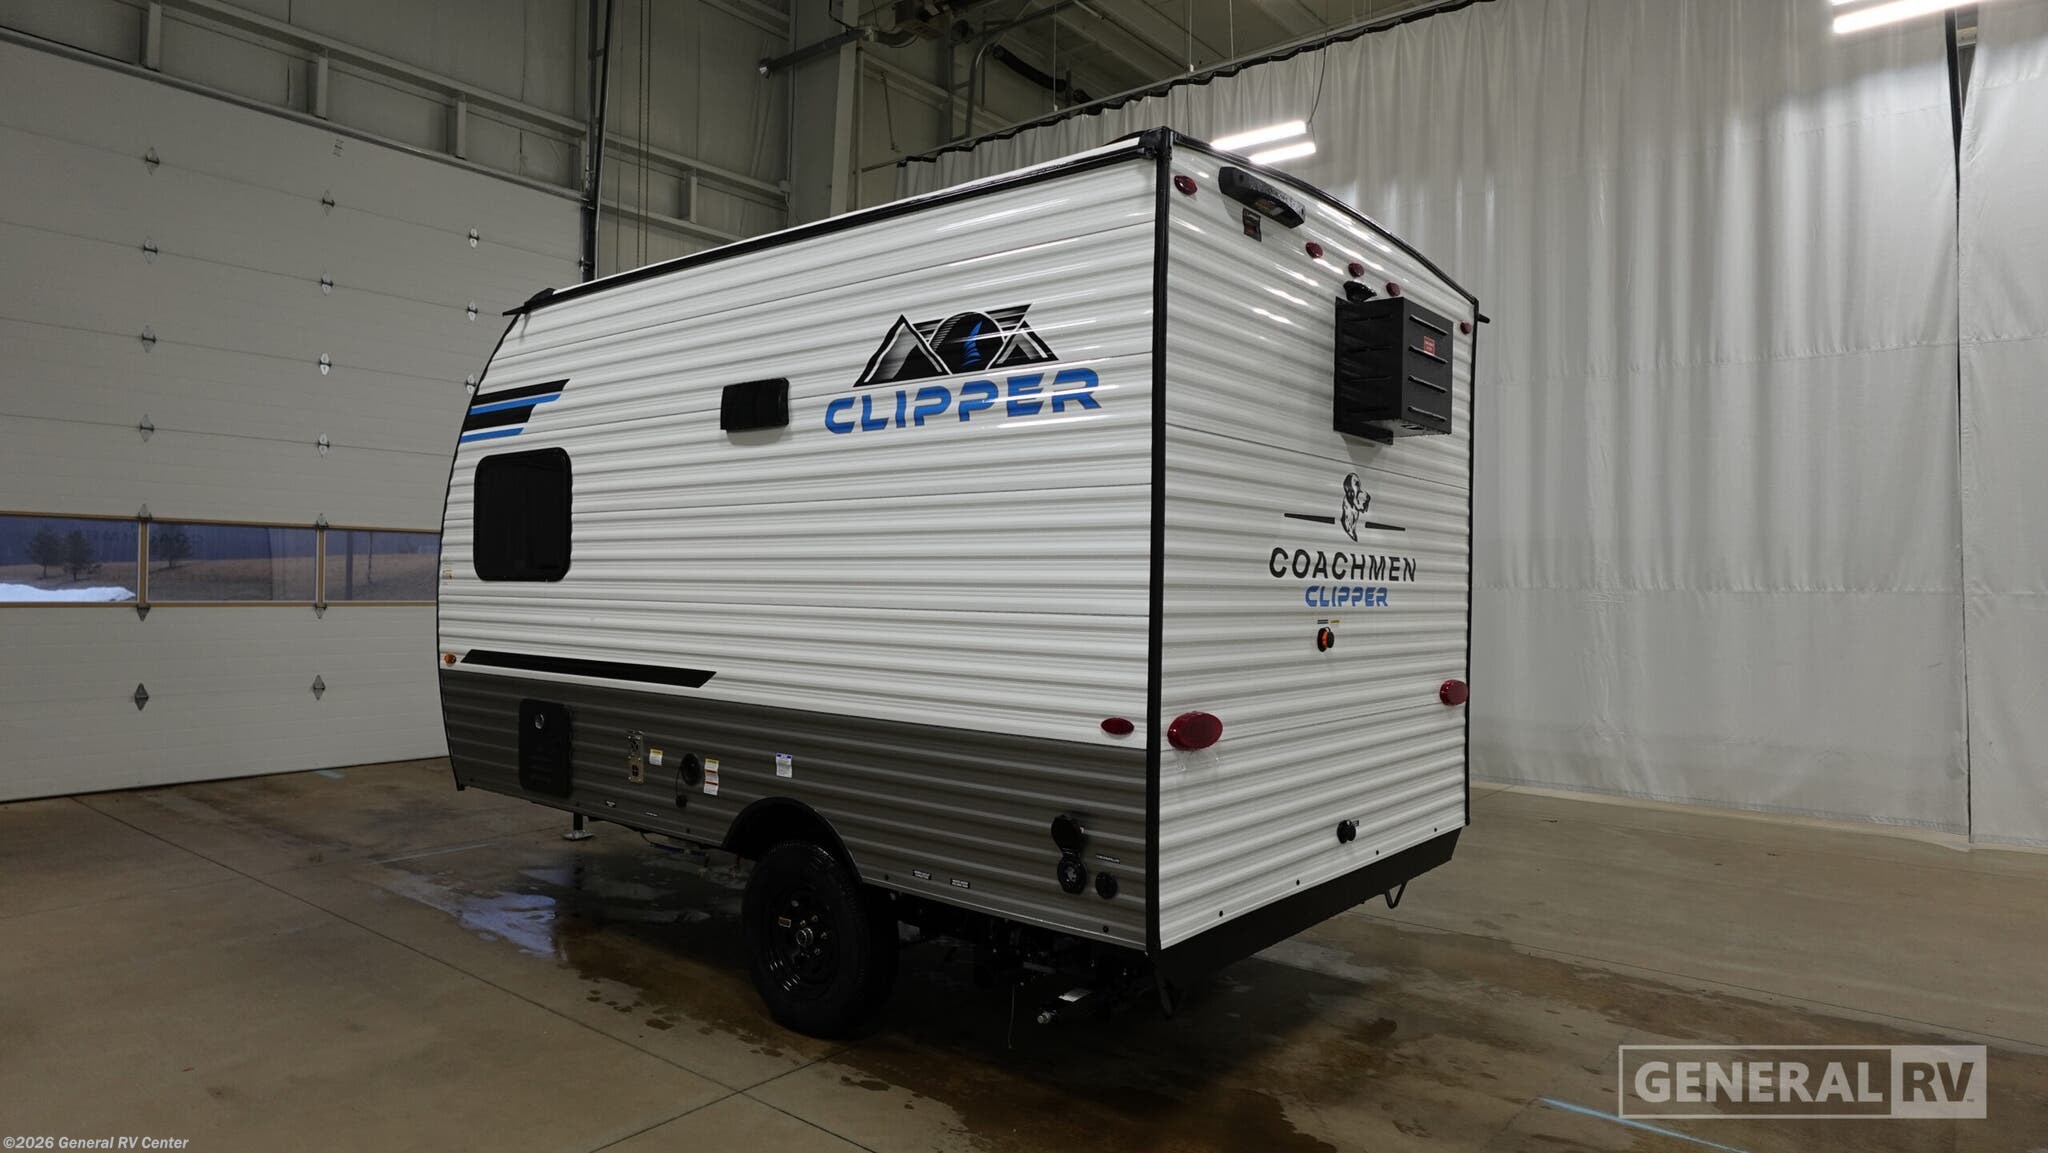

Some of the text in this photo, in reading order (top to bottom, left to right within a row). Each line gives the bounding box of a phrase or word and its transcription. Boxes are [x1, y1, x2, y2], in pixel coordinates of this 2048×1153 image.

[825, 367, 1102, 434] CLIPPER
[1269, 547, 1416, 582] COACHMEN
[1305, 585, 1388, 607] CLIPPER
